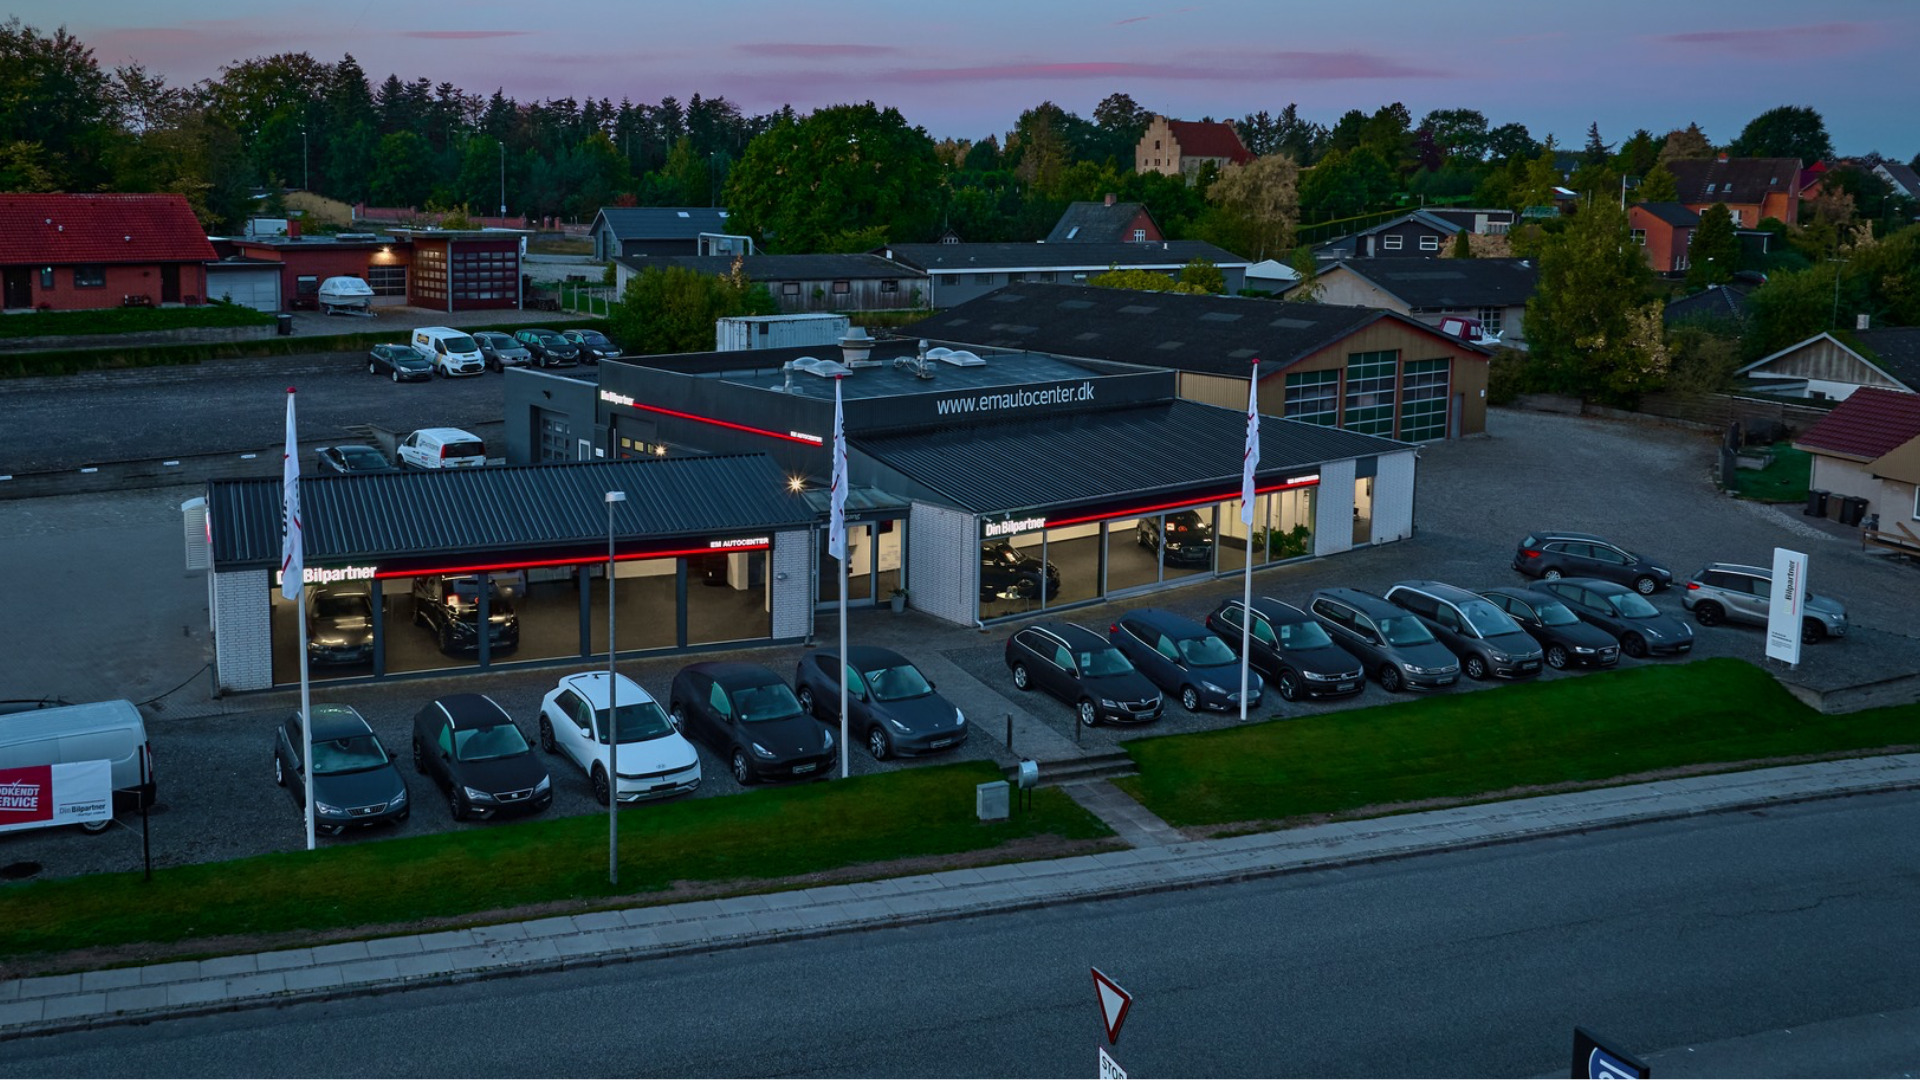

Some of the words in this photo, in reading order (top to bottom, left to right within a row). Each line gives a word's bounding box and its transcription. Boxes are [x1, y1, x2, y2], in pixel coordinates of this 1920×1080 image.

[937, 382, 1095, 415] www.emautocenter.dk
[986, 523, 1000, 536] Din
[1001, 518, 1046, 534] Bilpartner
[723, 537, 769, 547] AUTOCENTER
[303, 566, 377, 584] Bilpartner
[0, 787, 40, 796] DKENDT
